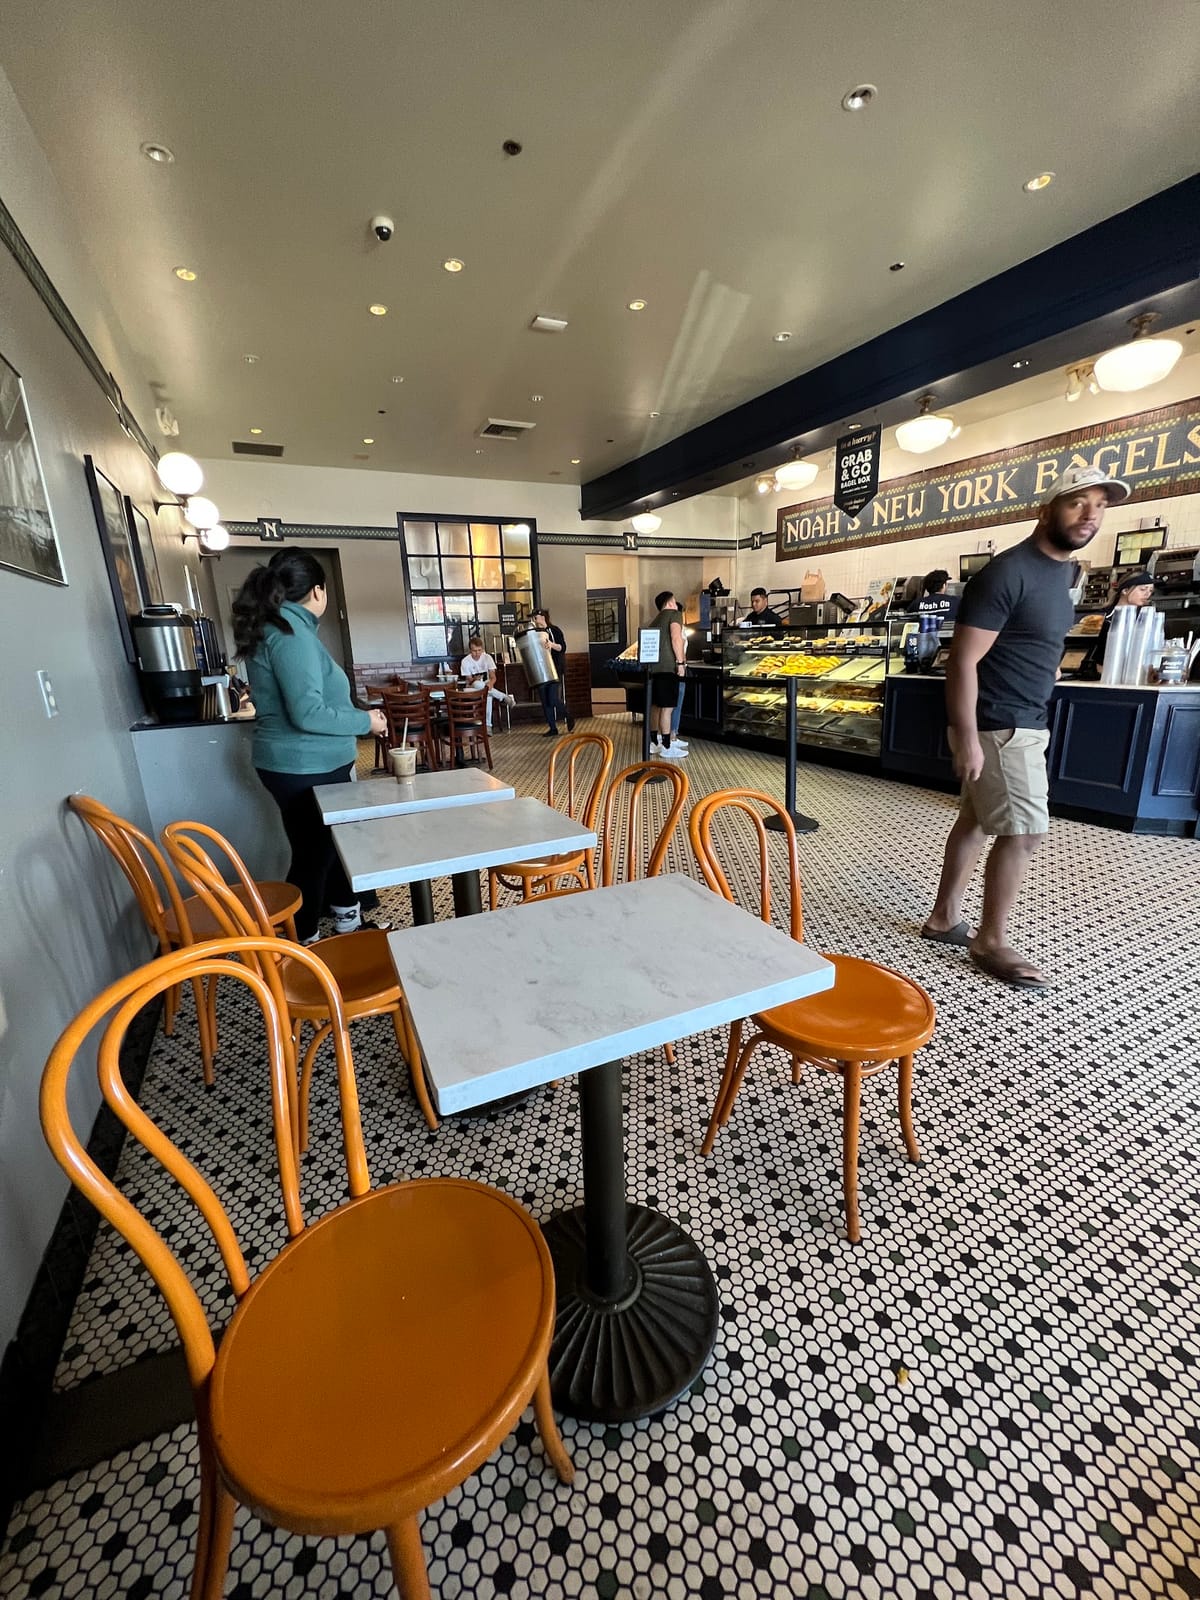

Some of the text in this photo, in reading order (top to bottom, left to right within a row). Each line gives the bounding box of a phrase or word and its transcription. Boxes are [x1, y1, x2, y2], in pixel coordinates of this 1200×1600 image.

[841, 449, 873, 469] GRAB
[841, 462, 872, 481] & GO
[840, 475, 871, 489] BAGEL BOX
[872, 489, 926, 527] NEW
[938, 467, 1019, 513] YORK
[263, 521, 279, 538] N
[626, 535, 636, 548] N
[753, 534, 761, 547] N
[919, 600, 950, 610] Nosh On
